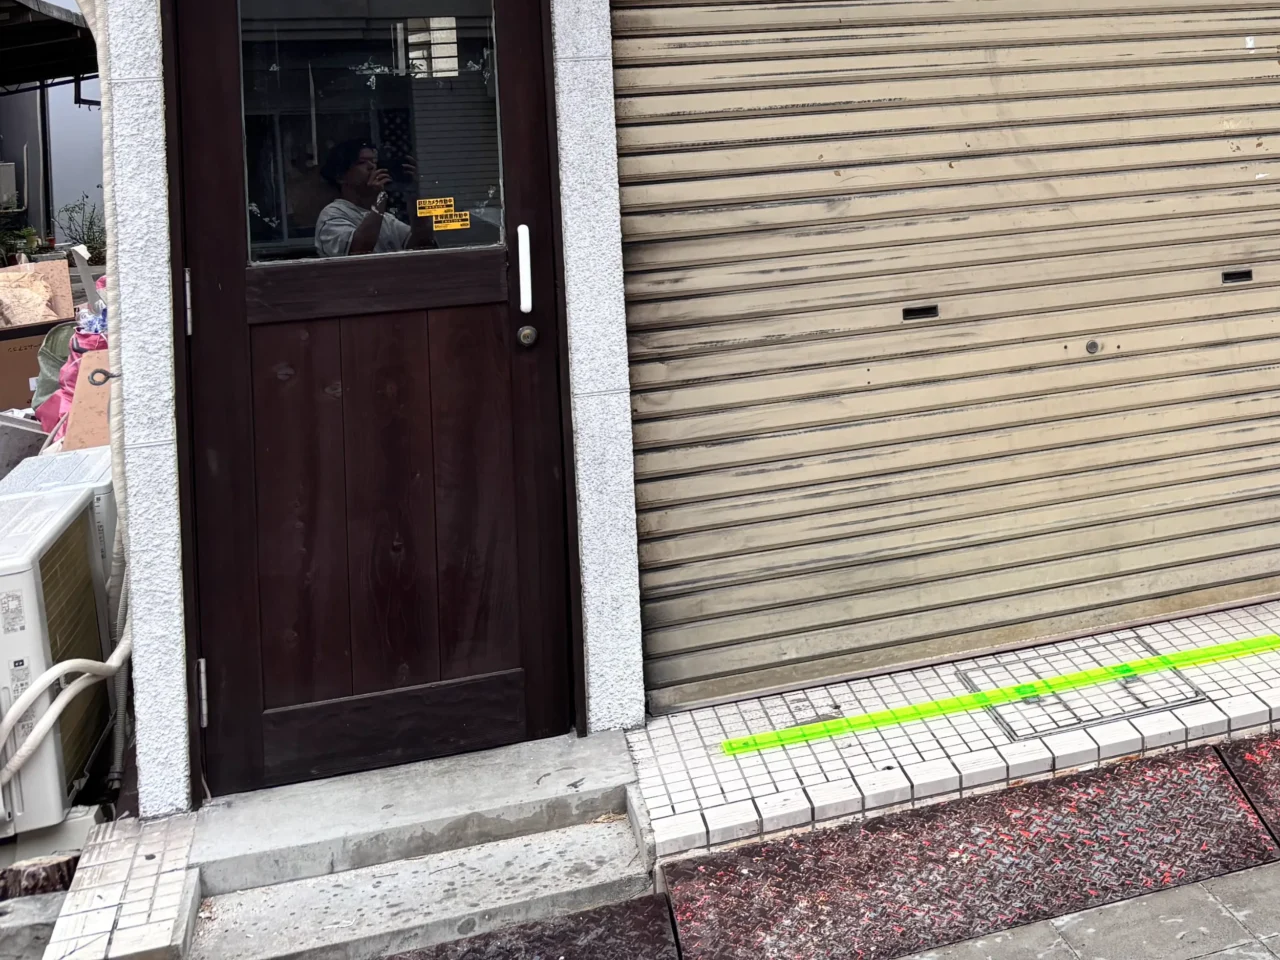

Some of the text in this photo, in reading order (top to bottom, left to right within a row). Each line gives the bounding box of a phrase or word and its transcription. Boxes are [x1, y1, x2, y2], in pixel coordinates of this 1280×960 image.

[8, 343, 42, 353] ームエアコン
